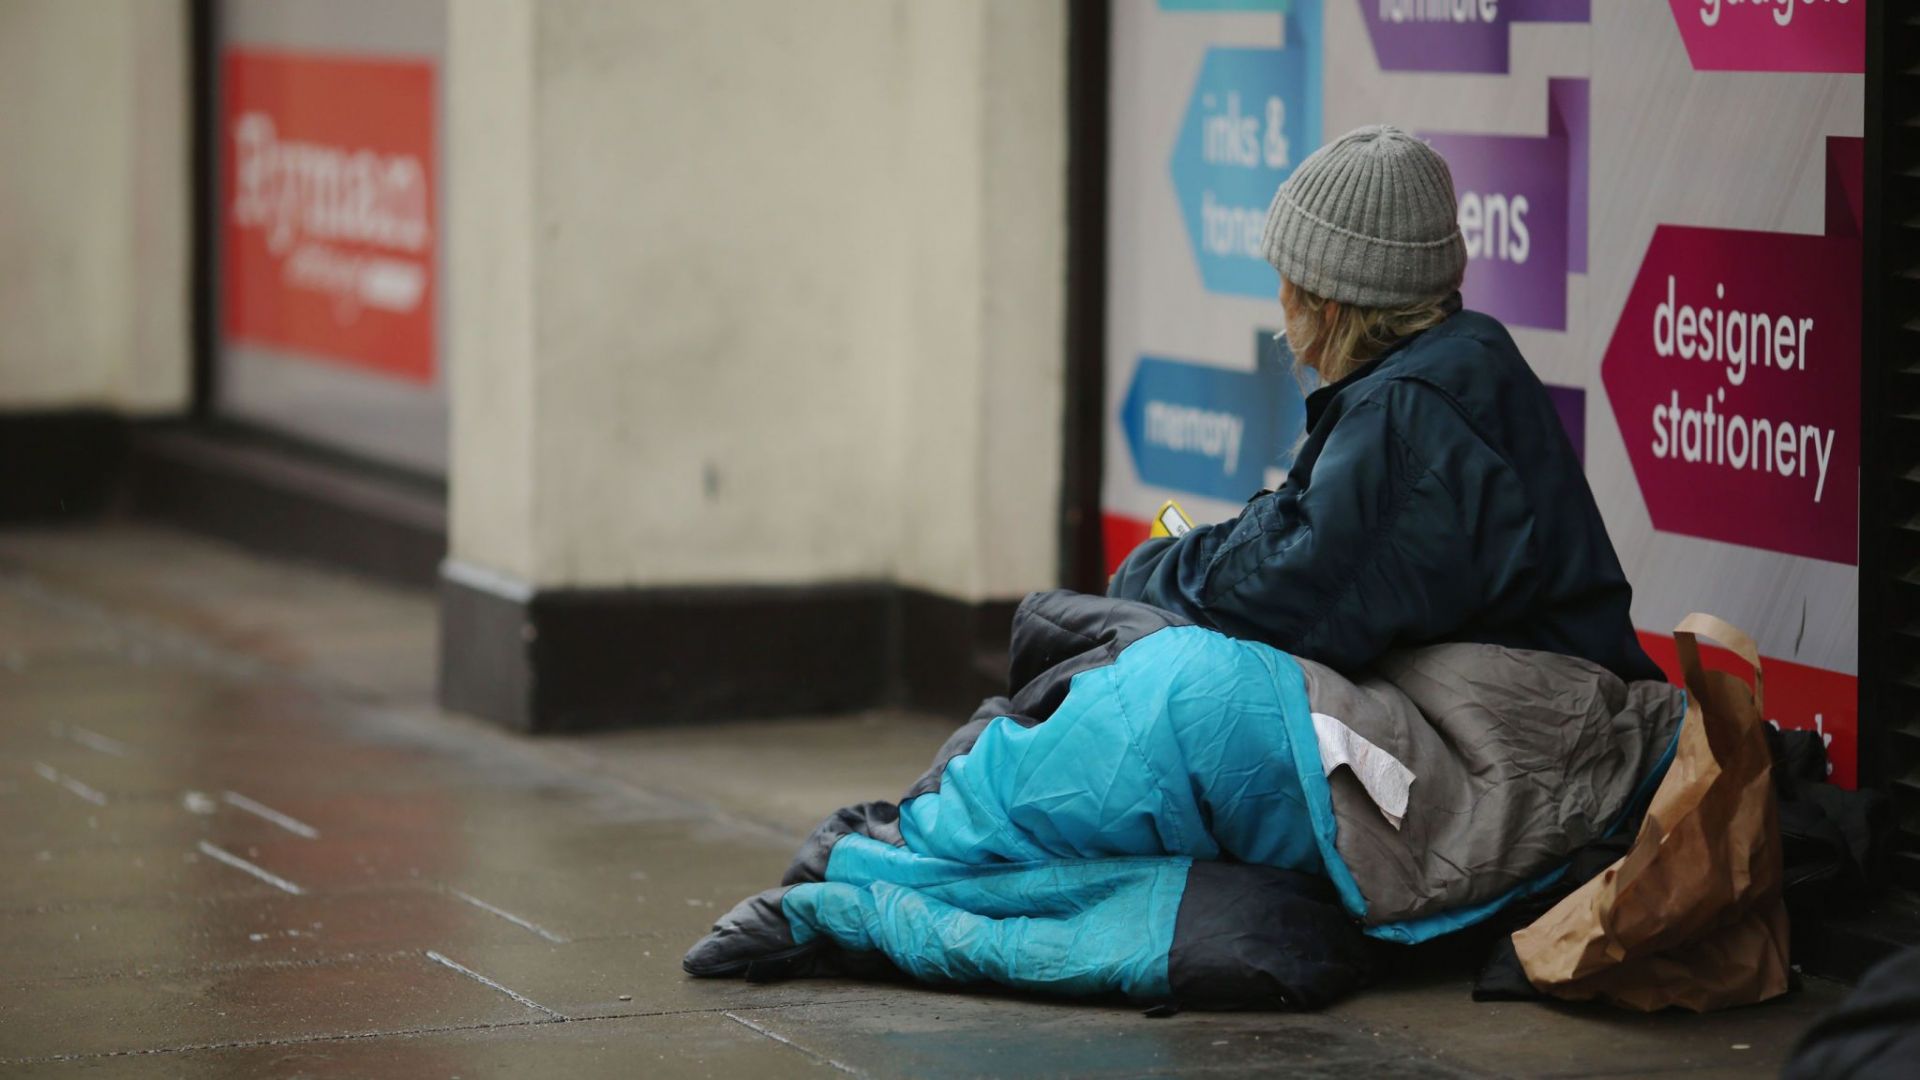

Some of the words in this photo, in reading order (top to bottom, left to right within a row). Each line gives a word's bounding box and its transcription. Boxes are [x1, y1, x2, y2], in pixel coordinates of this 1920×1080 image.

[1203, 92, 1259, 168] inks
[1264, 95, 1290, 169] &
[1203, 190, 1267, 259] tone
[1458, 191, 1530, 264] ens
[1653, 275, 1814, 386] designer
[1144, 401, 1244, 476] memory
[1652, 387, 1835, 502] stationery
